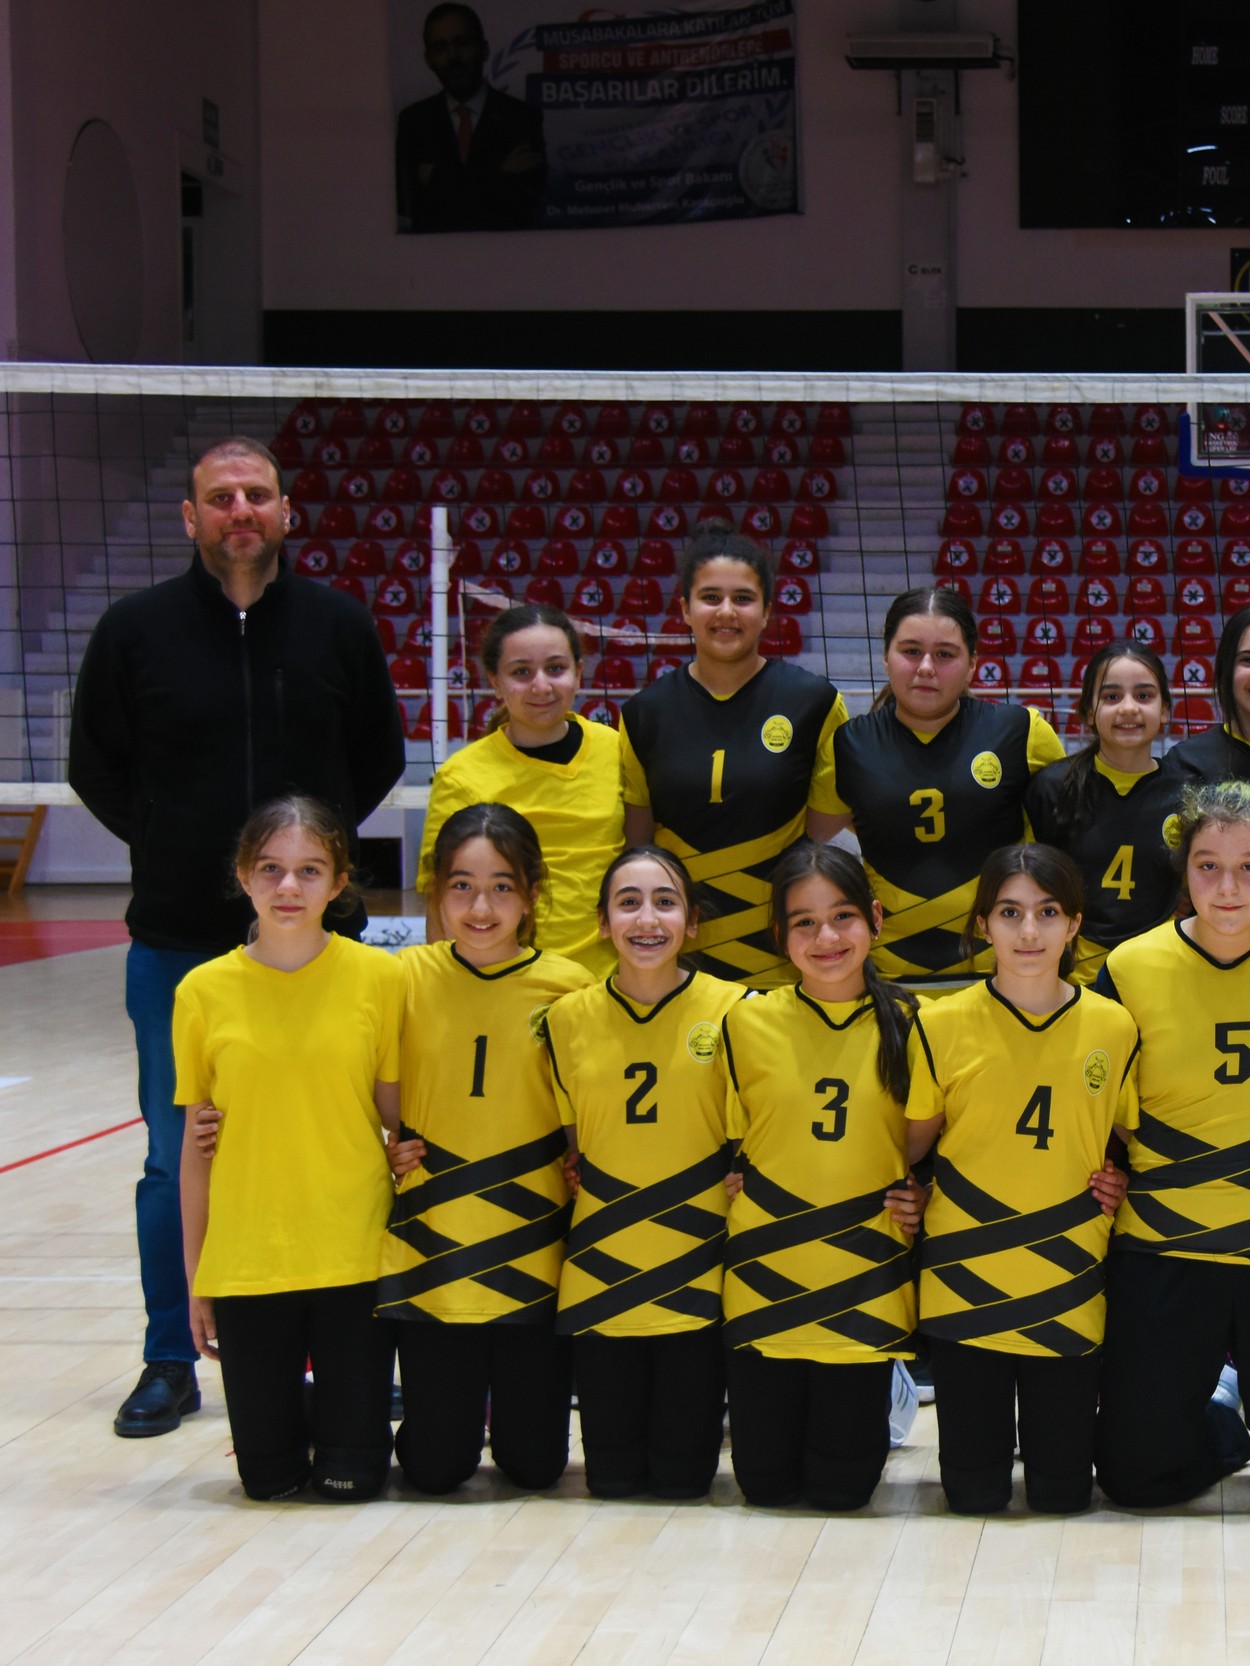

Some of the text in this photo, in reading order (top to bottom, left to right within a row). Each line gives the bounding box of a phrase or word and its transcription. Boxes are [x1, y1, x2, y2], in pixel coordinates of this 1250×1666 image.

[544, 19, 680, 45] MÜSABAKALARA
[684, 11, 751, 35] KATILAN
[559, 51, 621, 68] SPORCU
[628, 51, 645, 66] VE
[1192, 46, 1218, 64] HOME
[542, 77, 678, 109] BAŞARILAR
[1220, 105, 1248, 124] SCORE
[575, 180, 626, 193] Gençlik
[631, 179, 646, 188] ve
[1202, 166, 1229, 185] FOUL
[547, 206, 564, 215] Dr.
[908, 265, 918, 274] C
[711, 749, 725, 804] 1
[909, 788, 945, 842] 3
[1101, 845, 1136, 900] 4
[470, 1035, 488, 1097] 1
[624, 1062, 658, 1124] 2
[812, 1078, 849, 1142] 3
[1016, 1086, 1055, 1150] 4
